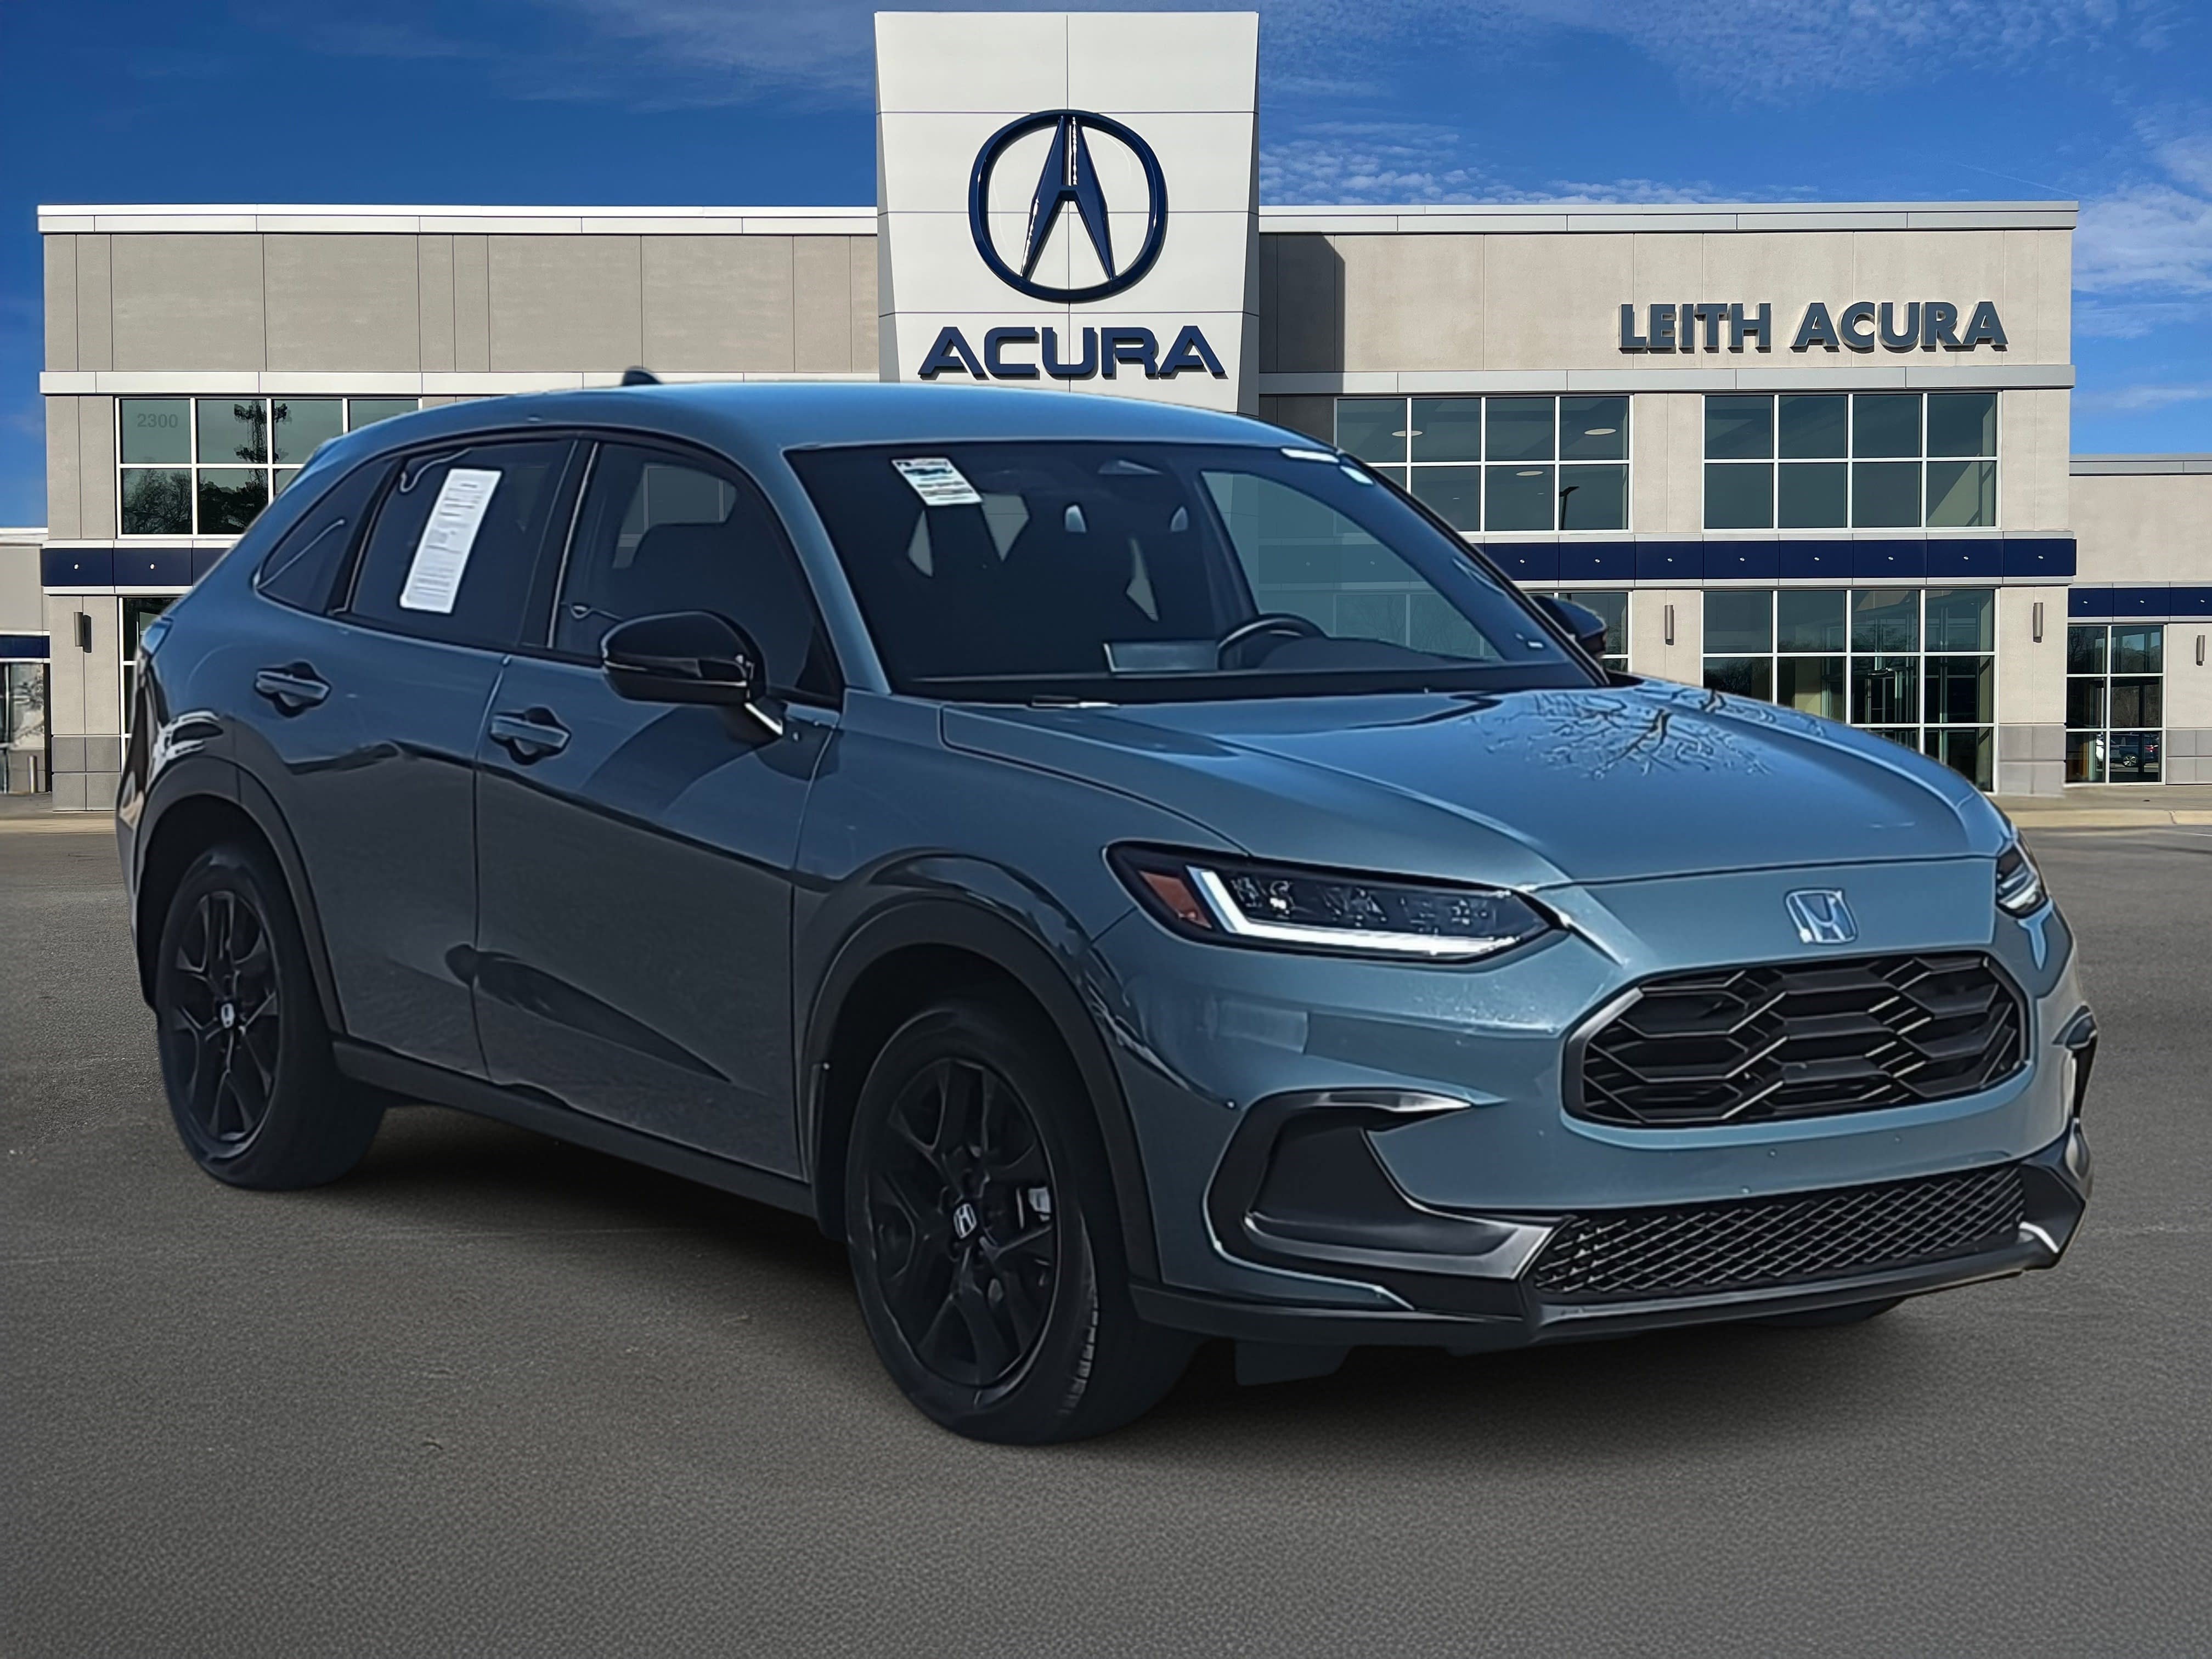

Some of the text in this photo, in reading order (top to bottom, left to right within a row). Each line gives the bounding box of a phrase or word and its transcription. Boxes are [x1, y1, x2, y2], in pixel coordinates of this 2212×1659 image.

[918, 326, 1228, 380] ACURA
[1618, 301, 2008, 353] LEITH ACURA
[137, 413, 178, 428] 2300
